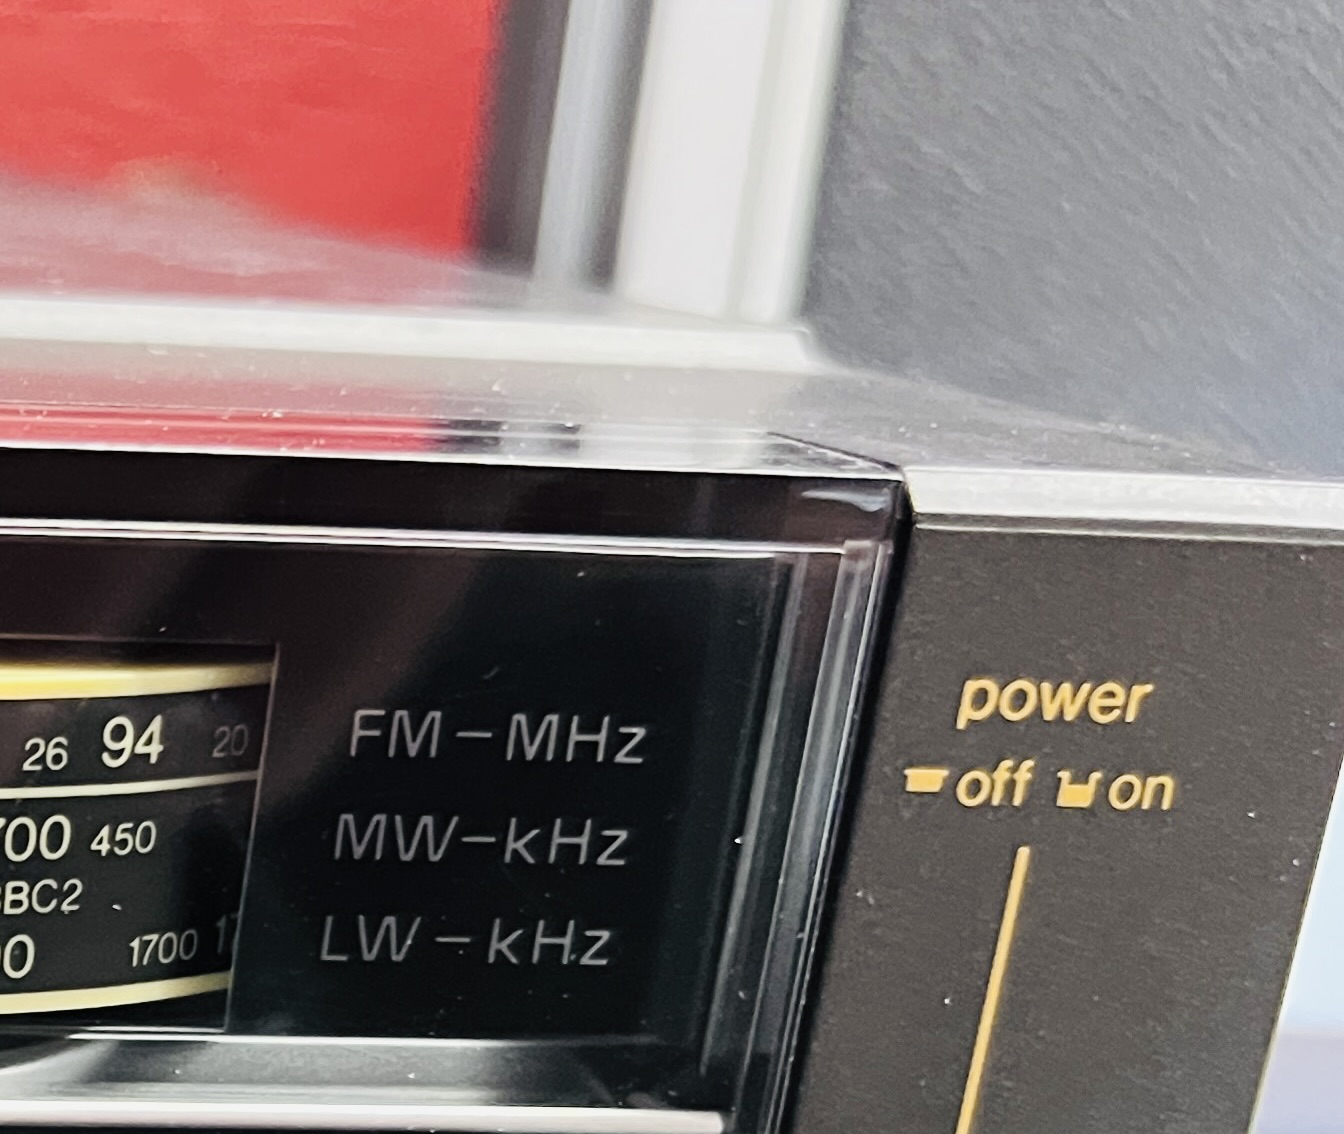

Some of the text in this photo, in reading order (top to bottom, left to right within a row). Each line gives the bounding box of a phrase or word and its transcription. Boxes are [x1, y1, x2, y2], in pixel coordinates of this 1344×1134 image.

[955, 676, 1154, 730] power
[22, 736, 69, 771] 26
[101, 714, 165, 768] 94
[212, 724, 249, 758] 20
[955, 759, 1174, 811] off on
[90, 820, 157, 857] 450
[129, 929, 198, 967] 1700
